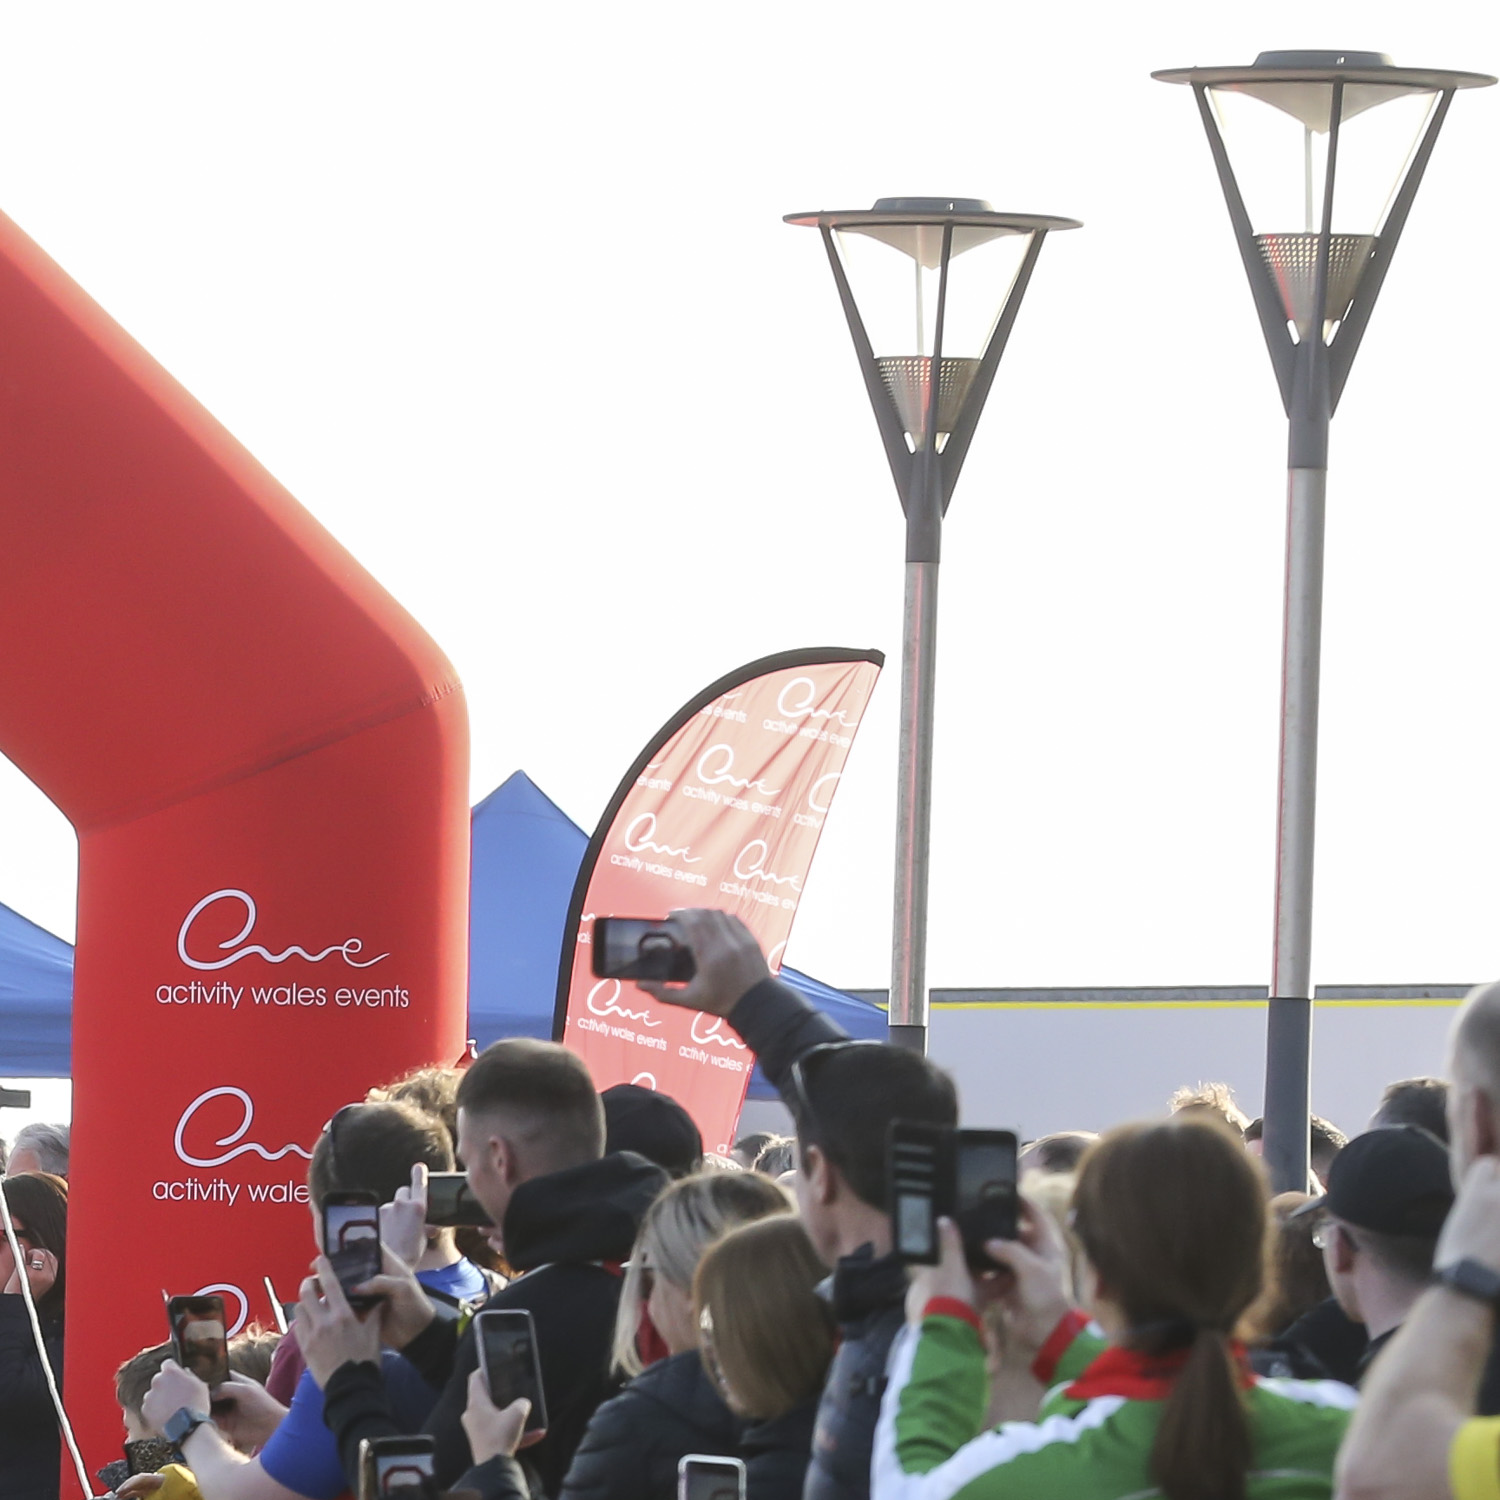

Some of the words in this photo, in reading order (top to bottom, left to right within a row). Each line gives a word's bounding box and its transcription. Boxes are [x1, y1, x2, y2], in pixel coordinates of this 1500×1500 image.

[157, 982, 243, 1009] activity
[252, 983, 326, 1005] wales
[336, 985, 408, 1007] events
[153, 1178, 239, 1206] activity
